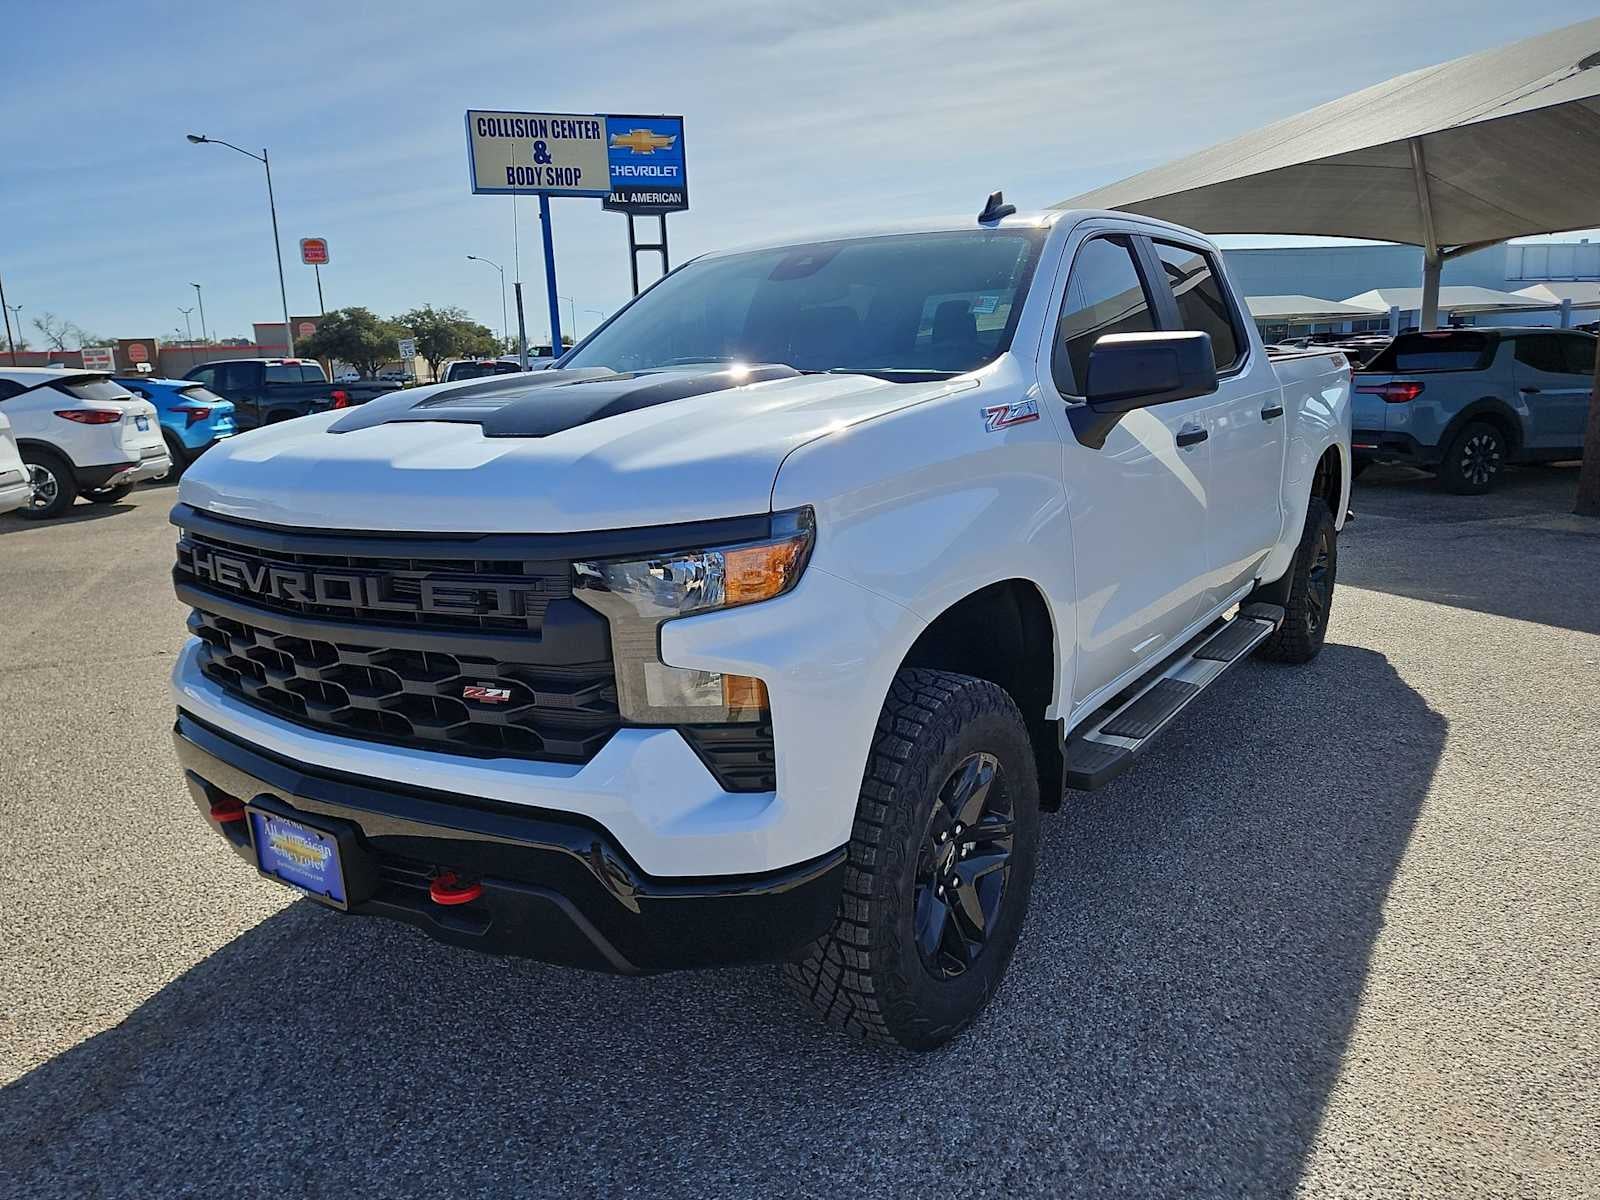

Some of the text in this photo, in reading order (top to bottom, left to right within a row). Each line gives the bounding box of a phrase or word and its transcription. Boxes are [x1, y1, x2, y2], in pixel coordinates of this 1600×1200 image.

[477, 117, 601, 140] COLLISION CENTER
[533, 140, 552, 165] &
[506, 166, 582, 186] BODY SHOP
[609, 192, 682, 203] ALL AMERICAN
[401, 348, 414, 357] 35
[980, 399, 1040, 433] Z71
[175, 544, 540, 617] CHEVROLET
[462, 686, 512, 702] Z71
